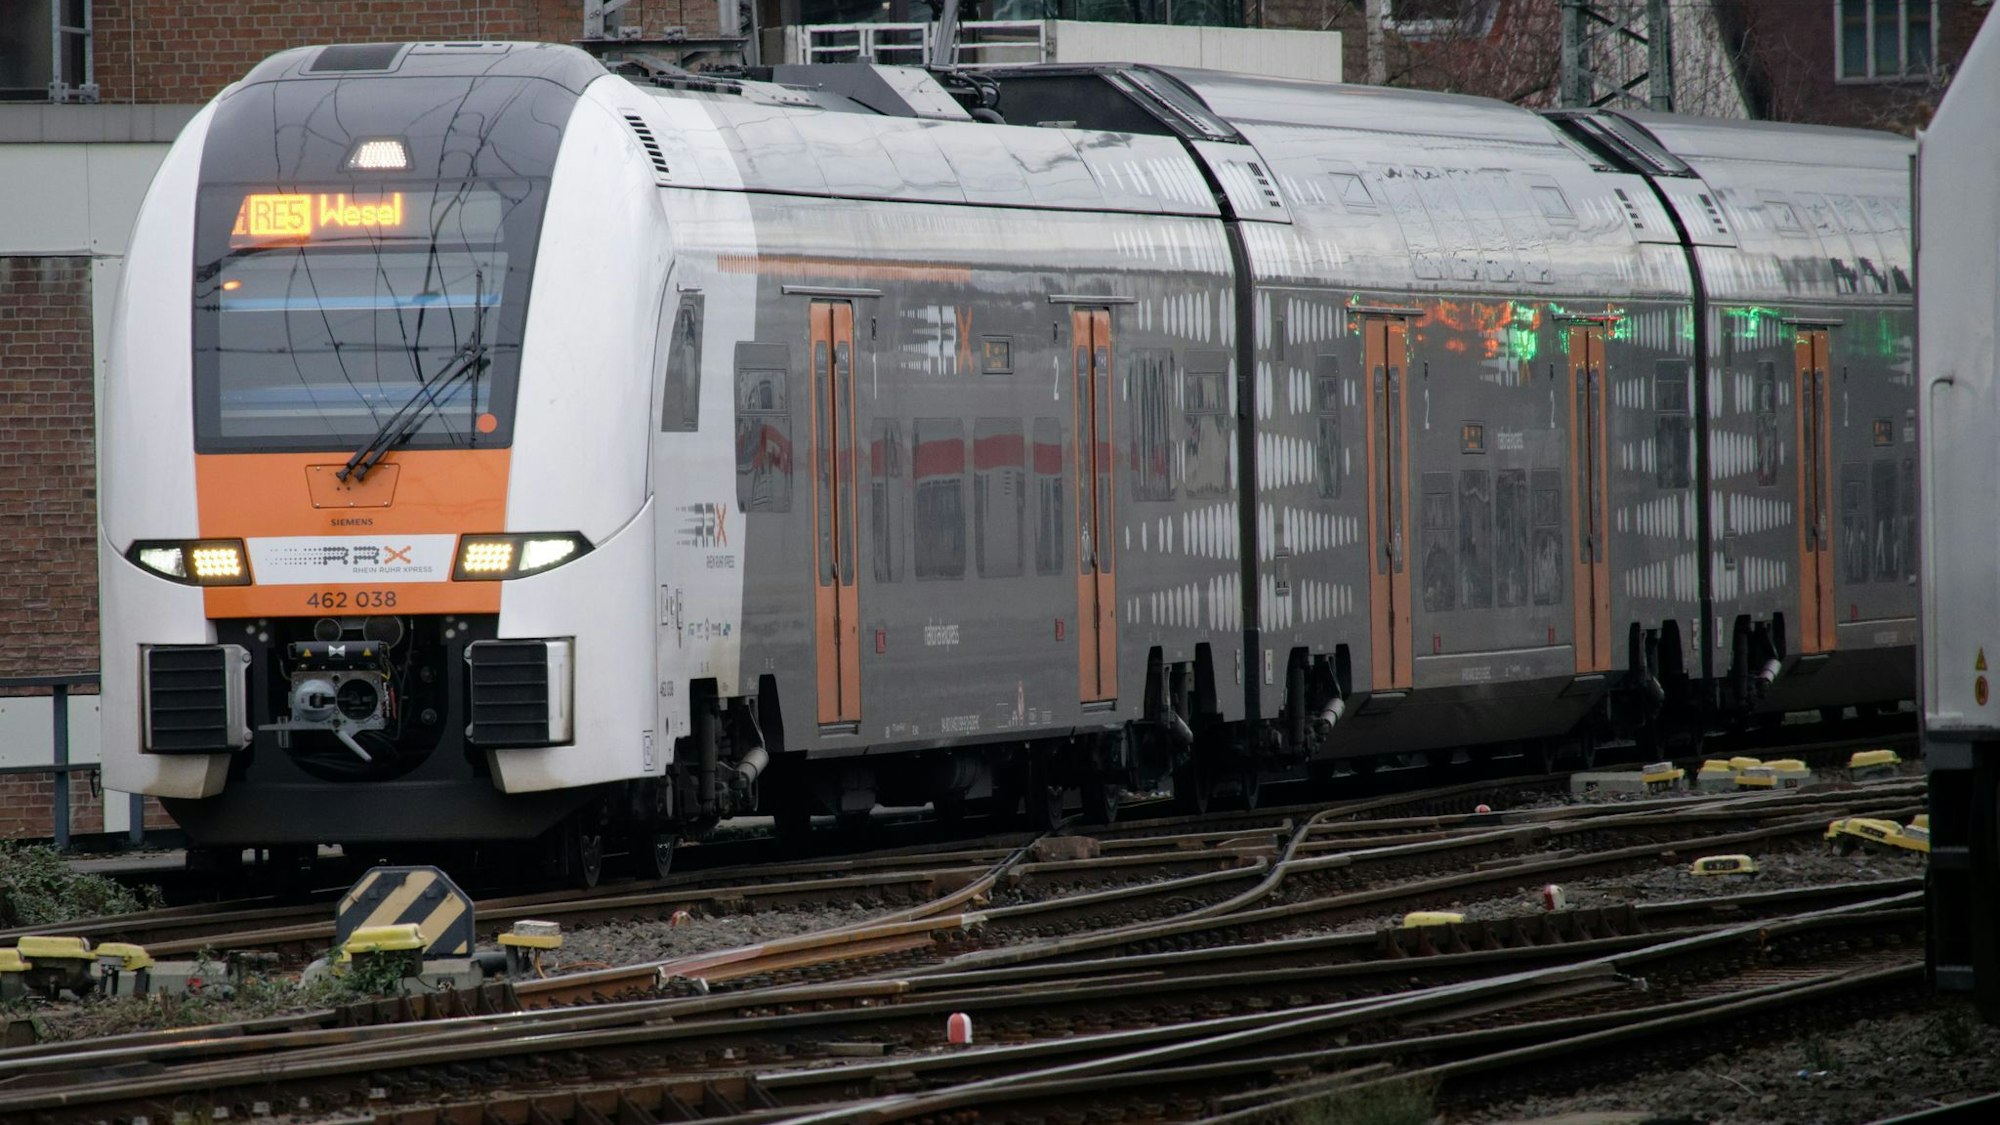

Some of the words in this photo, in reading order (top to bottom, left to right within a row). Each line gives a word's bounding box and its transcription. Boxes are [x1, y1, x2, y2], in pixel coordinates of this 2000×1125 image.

[254, 198, 306, 231] RE5
[319, 192, 402, 227] Wesel
[330, 518, 374, 527] SIEMENS
[322, 545, 412, 566] RRX
[352, 566, 377, 574] RHEIN
[379, 566, 401, 574] RUHR
[307, 592, 347, 608] 462
[356, 591, 396, 607] 038
